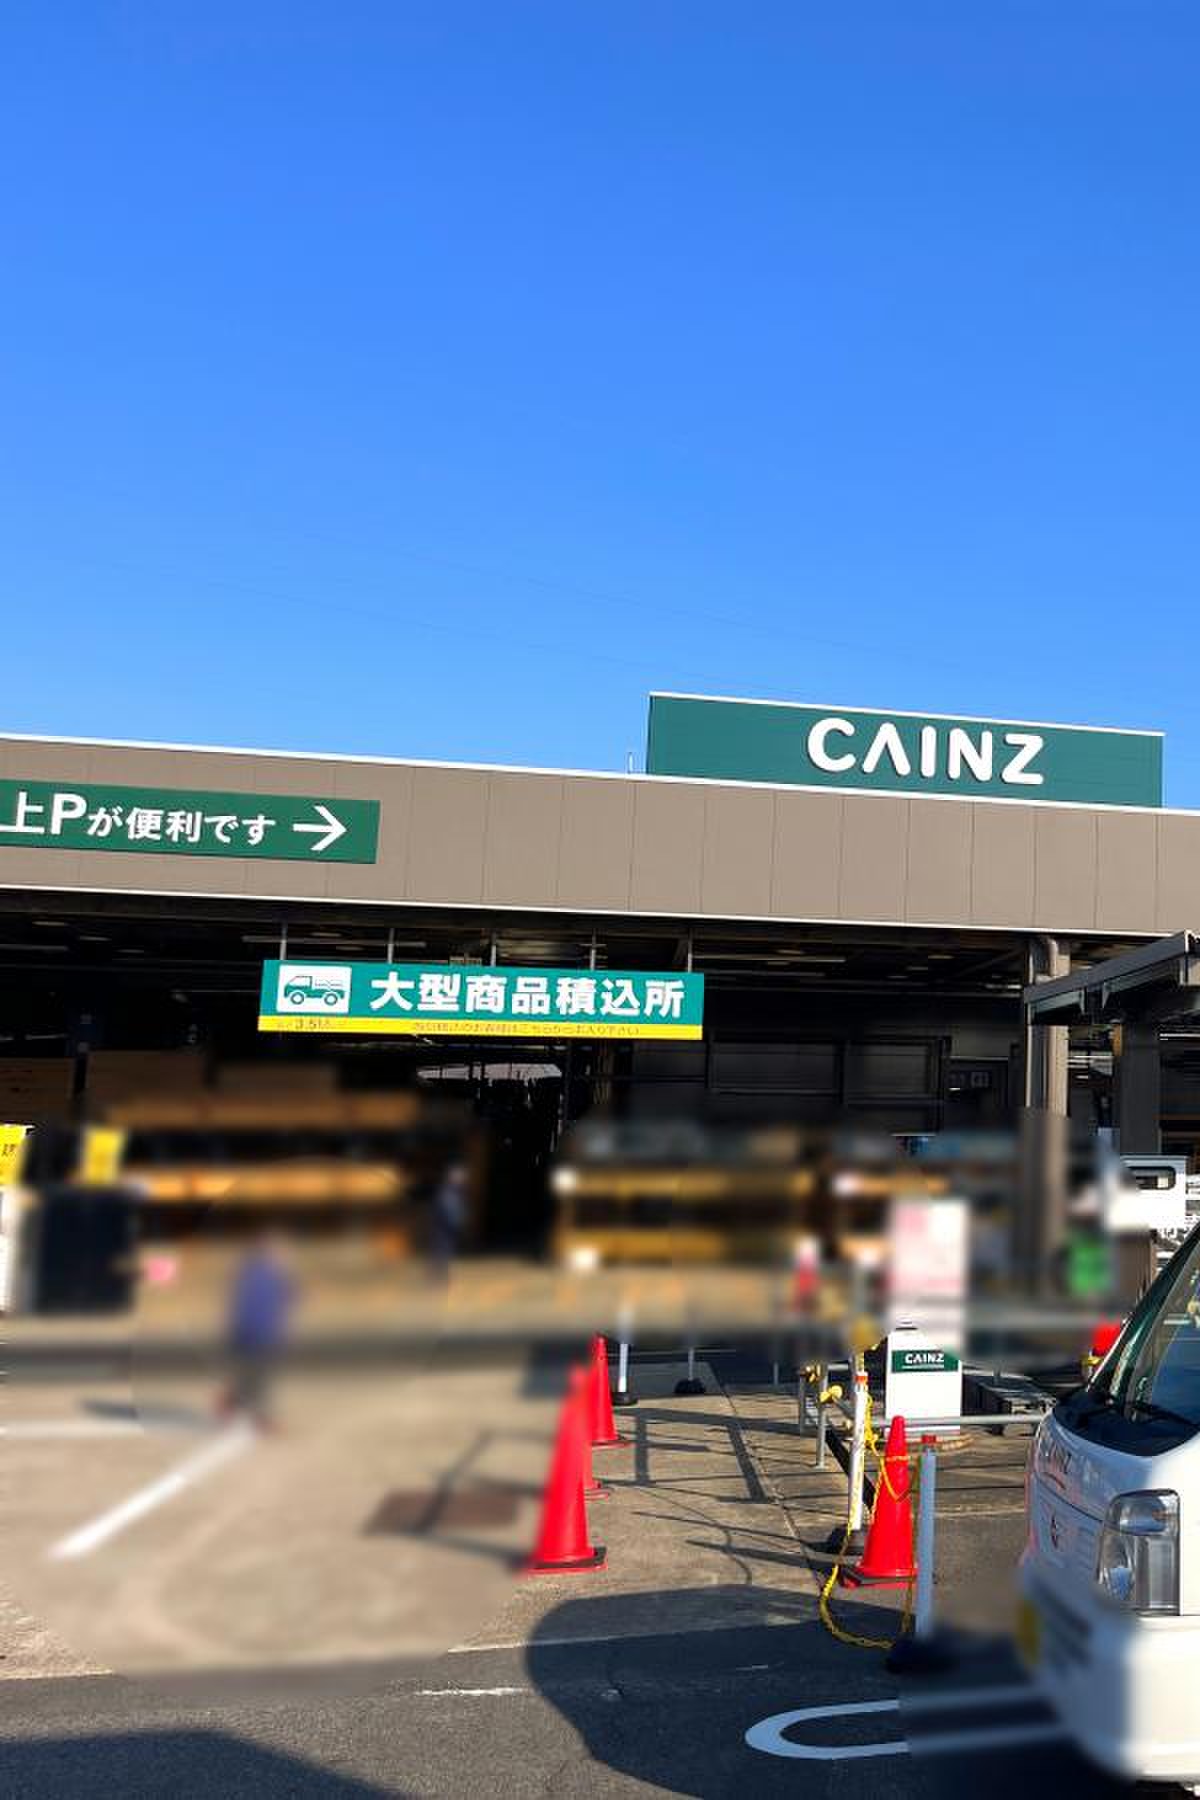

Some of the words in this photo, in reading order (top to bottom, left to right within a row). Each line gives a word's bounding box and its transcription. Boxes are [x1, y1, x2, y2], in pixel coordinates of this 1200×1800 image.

[807, 717, 1044, 786] CAINZ
[0, 791, 276, 846] 上Pが便利です
[369, 971, 685, 1018] 大型商品積込所
[904, 1353, 945, 1364] CAINZ
